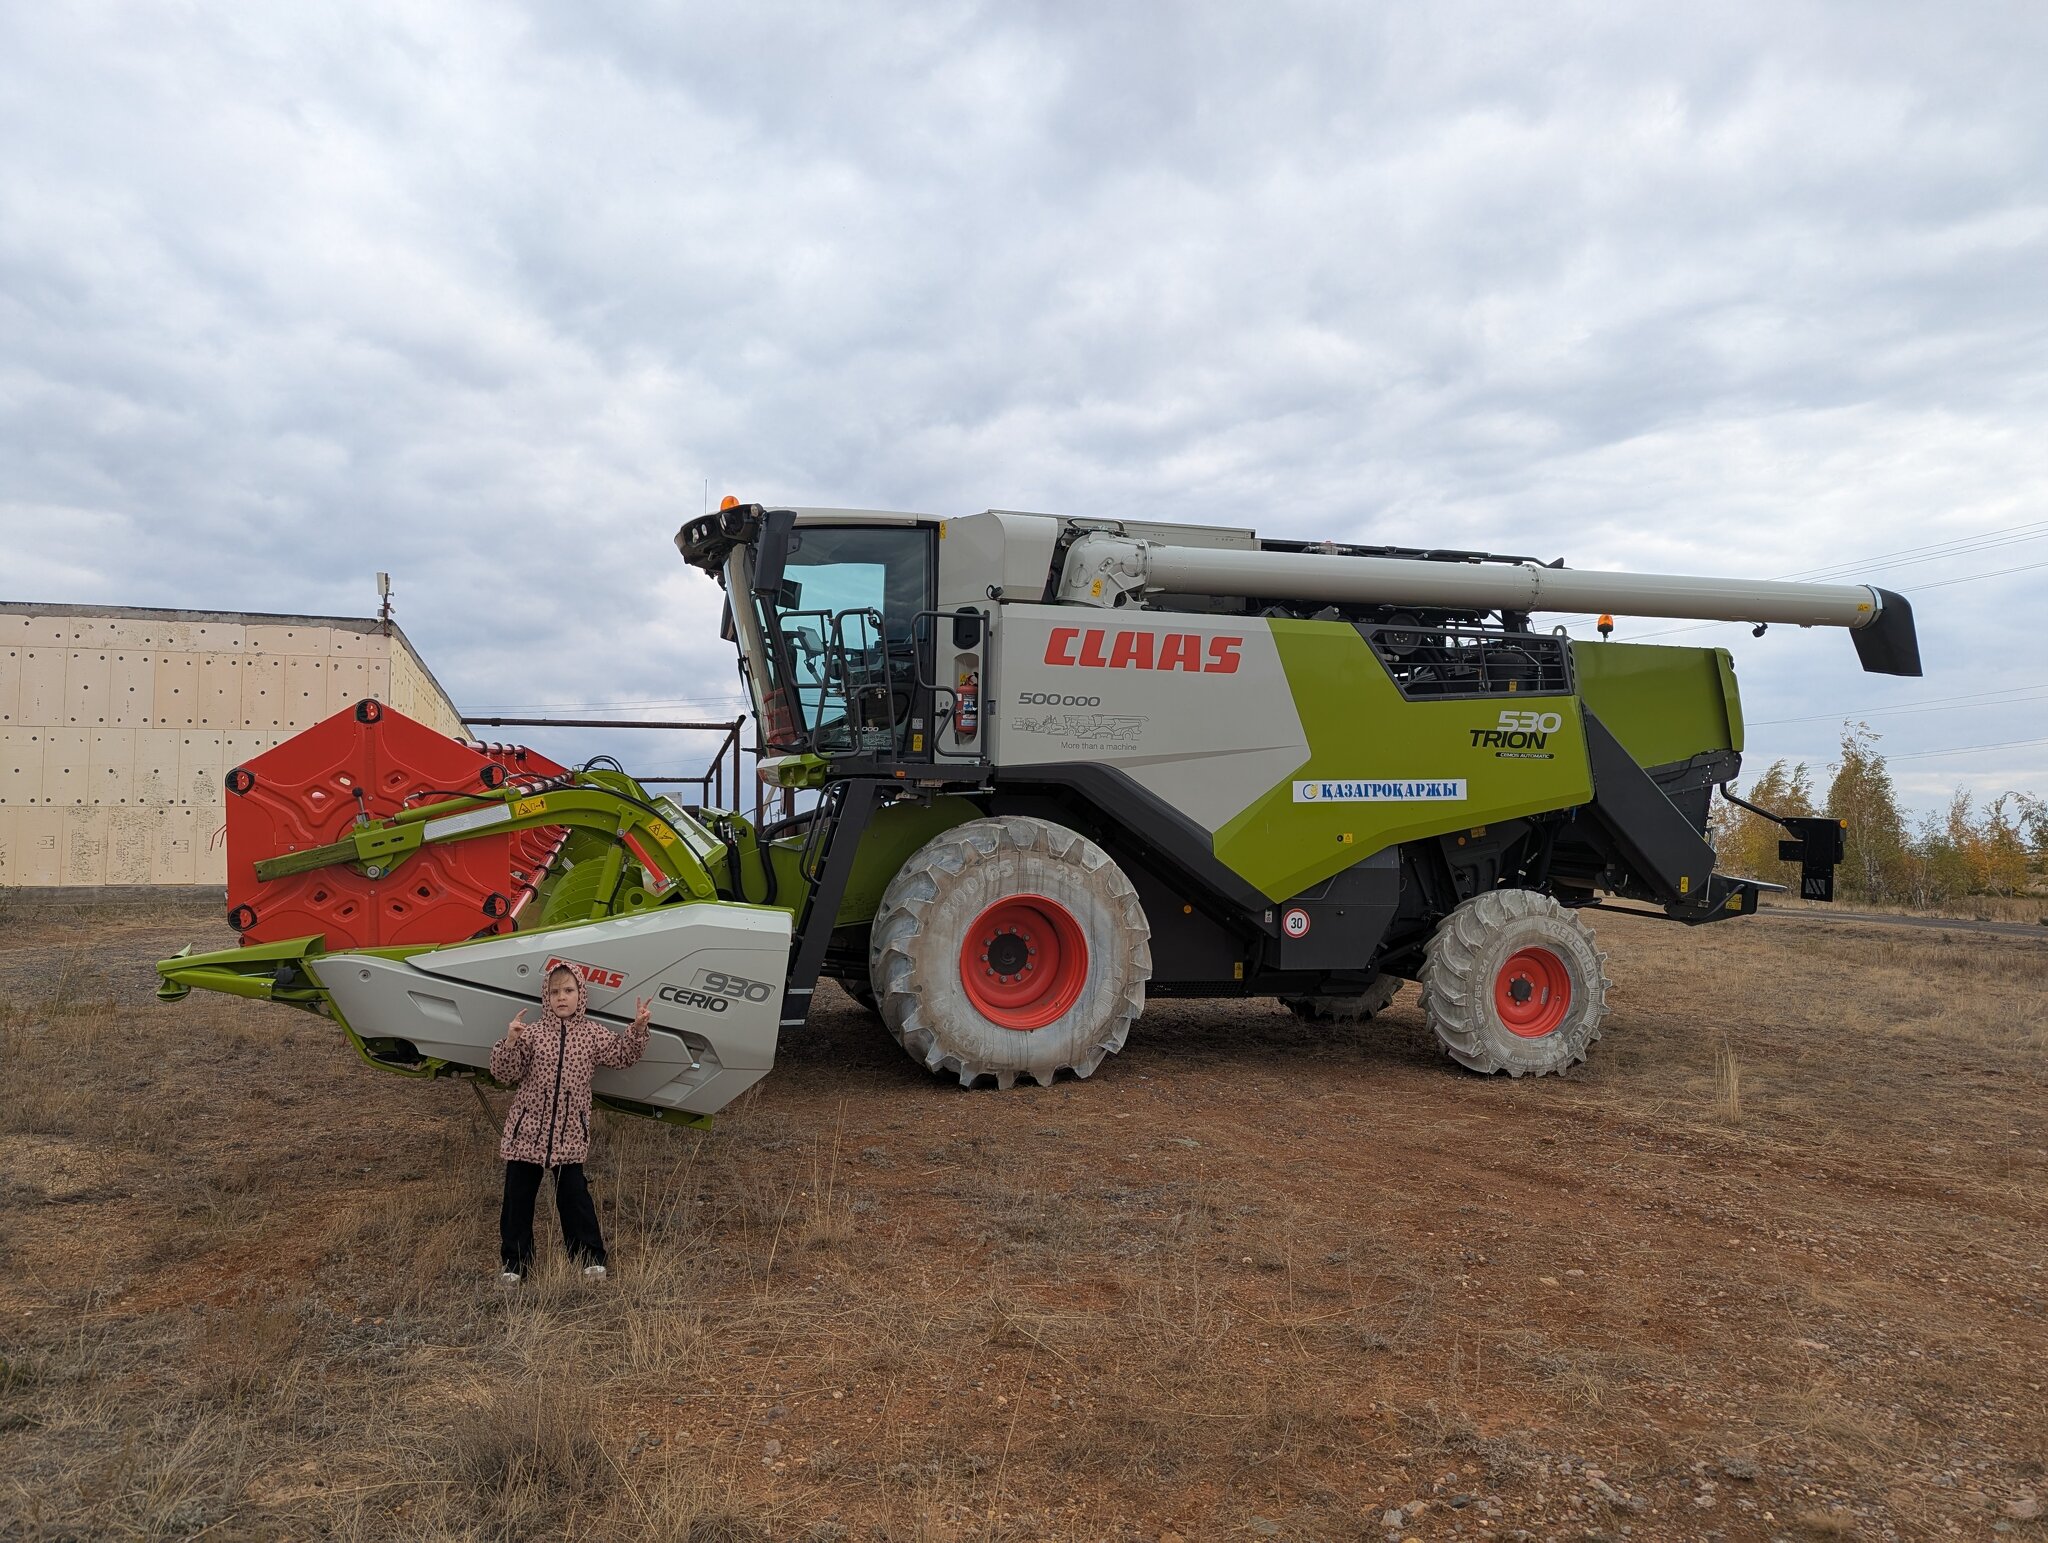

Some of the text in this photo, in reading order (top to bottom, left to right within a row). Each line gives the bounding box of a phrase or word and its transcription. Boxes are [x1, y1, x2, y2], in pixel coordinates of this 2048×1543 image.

[1044, 627, 1244, 674] CLAAS
[1018, 692, 1101, 707] 500 000
[1497, 710, 1562, 733] 530
[1061, 741, 1080, 750] More
[1081, 741, 1099, 750] than
[1107, 742, 1137, 751] machine
[1470, 729, 1548, 749] TRION
[1322, 782, 1458, 801] ҚАЗАГРОҚАРЖЫ
[1290, 917, 1303, 929] 30
[702, 973, 773, 1002] 930
[658, 986, 729, 1013] CERIO
[1474, 984, 1486, 1025] 500/85
